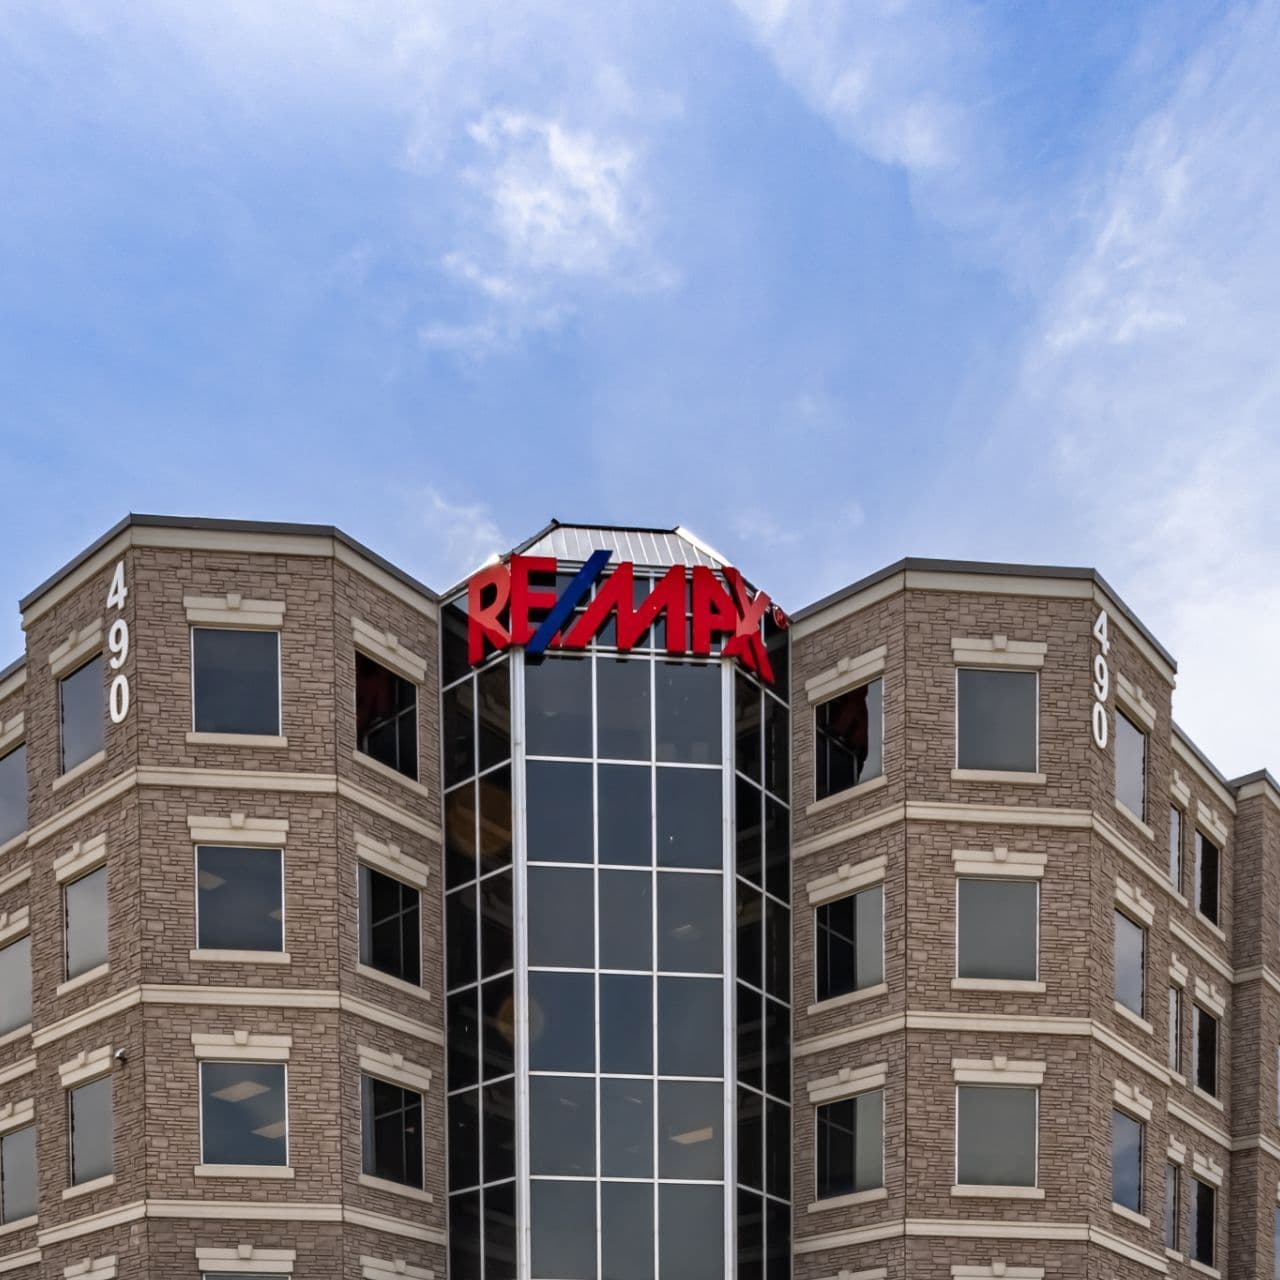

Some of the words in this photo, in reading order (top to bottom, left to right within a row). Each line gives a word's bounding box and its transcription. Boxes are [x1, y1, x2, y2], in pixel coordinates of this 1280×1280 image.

[106, 560, 130, 723] 490
[468, 550, 775, 684] RE/MAX
[1092, 609, 1111, 749] 490
